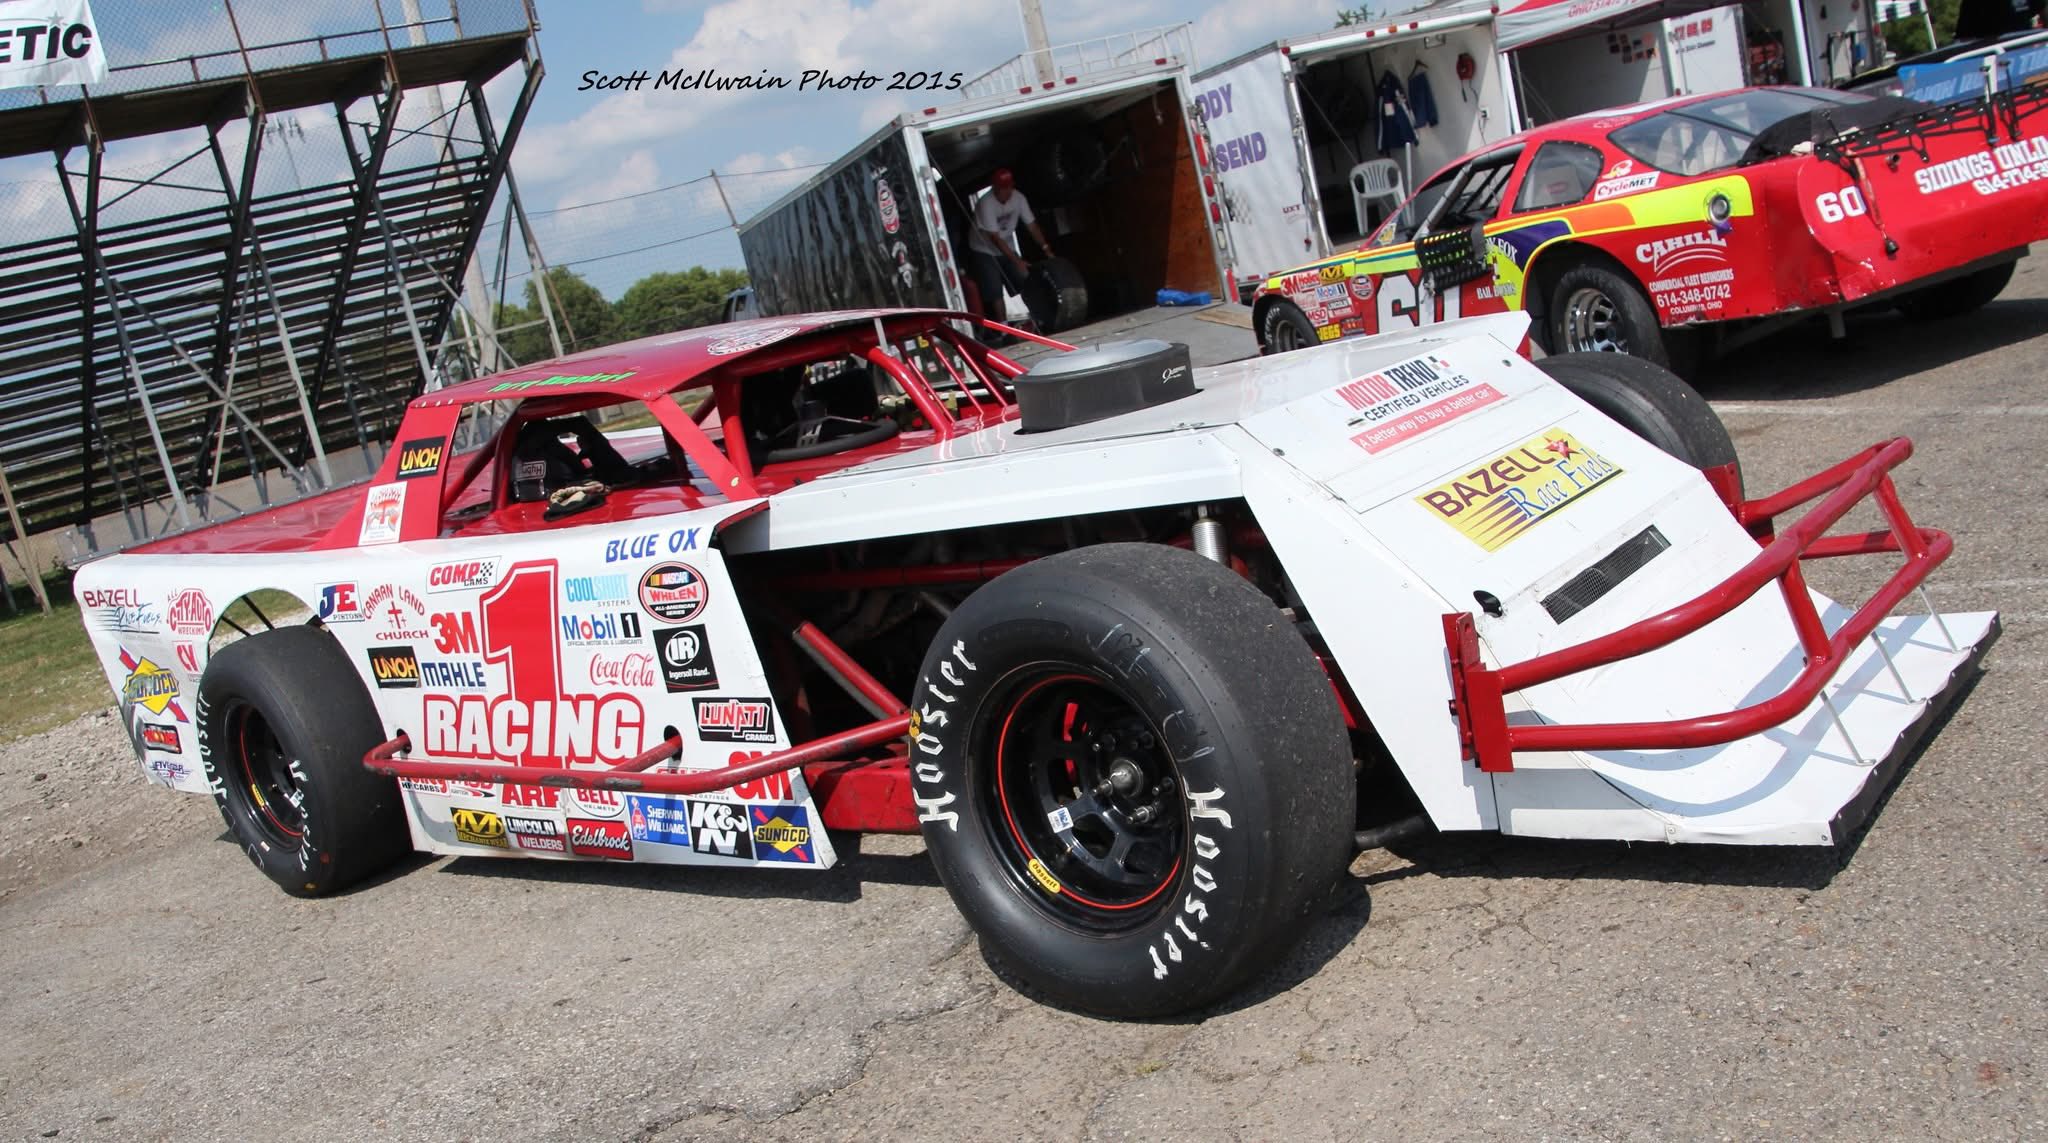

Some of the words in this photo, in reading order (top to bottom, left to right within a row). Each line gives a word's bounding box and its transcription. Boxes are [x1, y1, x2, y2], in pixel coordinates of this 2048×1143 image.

[1914, 151, 1996, 195] SIDINGS
[1816, 186, 1866, 223] 60
[1636, 229, 1727, 264] CAHILL
[1281, 275, 1300, 297] 3M
[1656, 283, 1732, 309] 614-348-0742
[1336, 374, 1401, 411] MOTOR
[1383, 359, 1440, 392] TREND
[1364, 392, 1421, 421] CERTIFIED
[1421, 374, 1470, 399] VEHICLES
[1359, 437, 1369, 449] A
[1370, 425, 1398, 445] better
[1397, 416, 1418, 433] way
[1415, 413, 1428, 425] to
[1428, 406, 1446, 422] buy
[1449, 394, 1475, 411] better
[401, 446, 442, 471] UNOH
[1423, 448, 1557, 519] BAZELL
[1504, 479, 1569, 519] Race
[1554, 448, 1614, 491] Fuels
[606, 534, 660, 563] BLUE
[668, 527, 702, 553] OX
[430, 562, 481, 587] COMP
[463, 576, 489, 587] CAMS
[83, 588, 143, 608] BAZELL
[320, 583, 357, 619] JE
[399, 585, 425, 616] LAND
[598, 600, 631, 608] SYSTEMS
[649, 586, 698, 603] WHELEN
[375, 629, 430, 641] CHURCH
[431, 611, 480, 654] 3M
[562, 613, 617, 640] Mobil
[670, 636, 694, 661] IR
[373, 657, 418, 679] UNOH
[421, 662, 487, 687] MAHLE
[590, 653, 655, 687] Coca-Cola
[425, 694, 643, 764] RACING
[700, 700, 765, 732] LUNATI
[745, 734, 775, 742] CRANKS
[912, 639, 977, 832] Hoosier
[413, 785, 441, 793] CARBS
[577, 787, 619, 807] BELL
[583, 803, 616, 812] HELMETS
[507, 817, 556, 836] LINCOLN
[571, 824, 631, 851] Edelbrock
[757, 827, 806, 842] SUNOCO
[520, 836, 565, 851] WELDERS
[1149, 776, 1233, 980] Hoosier
